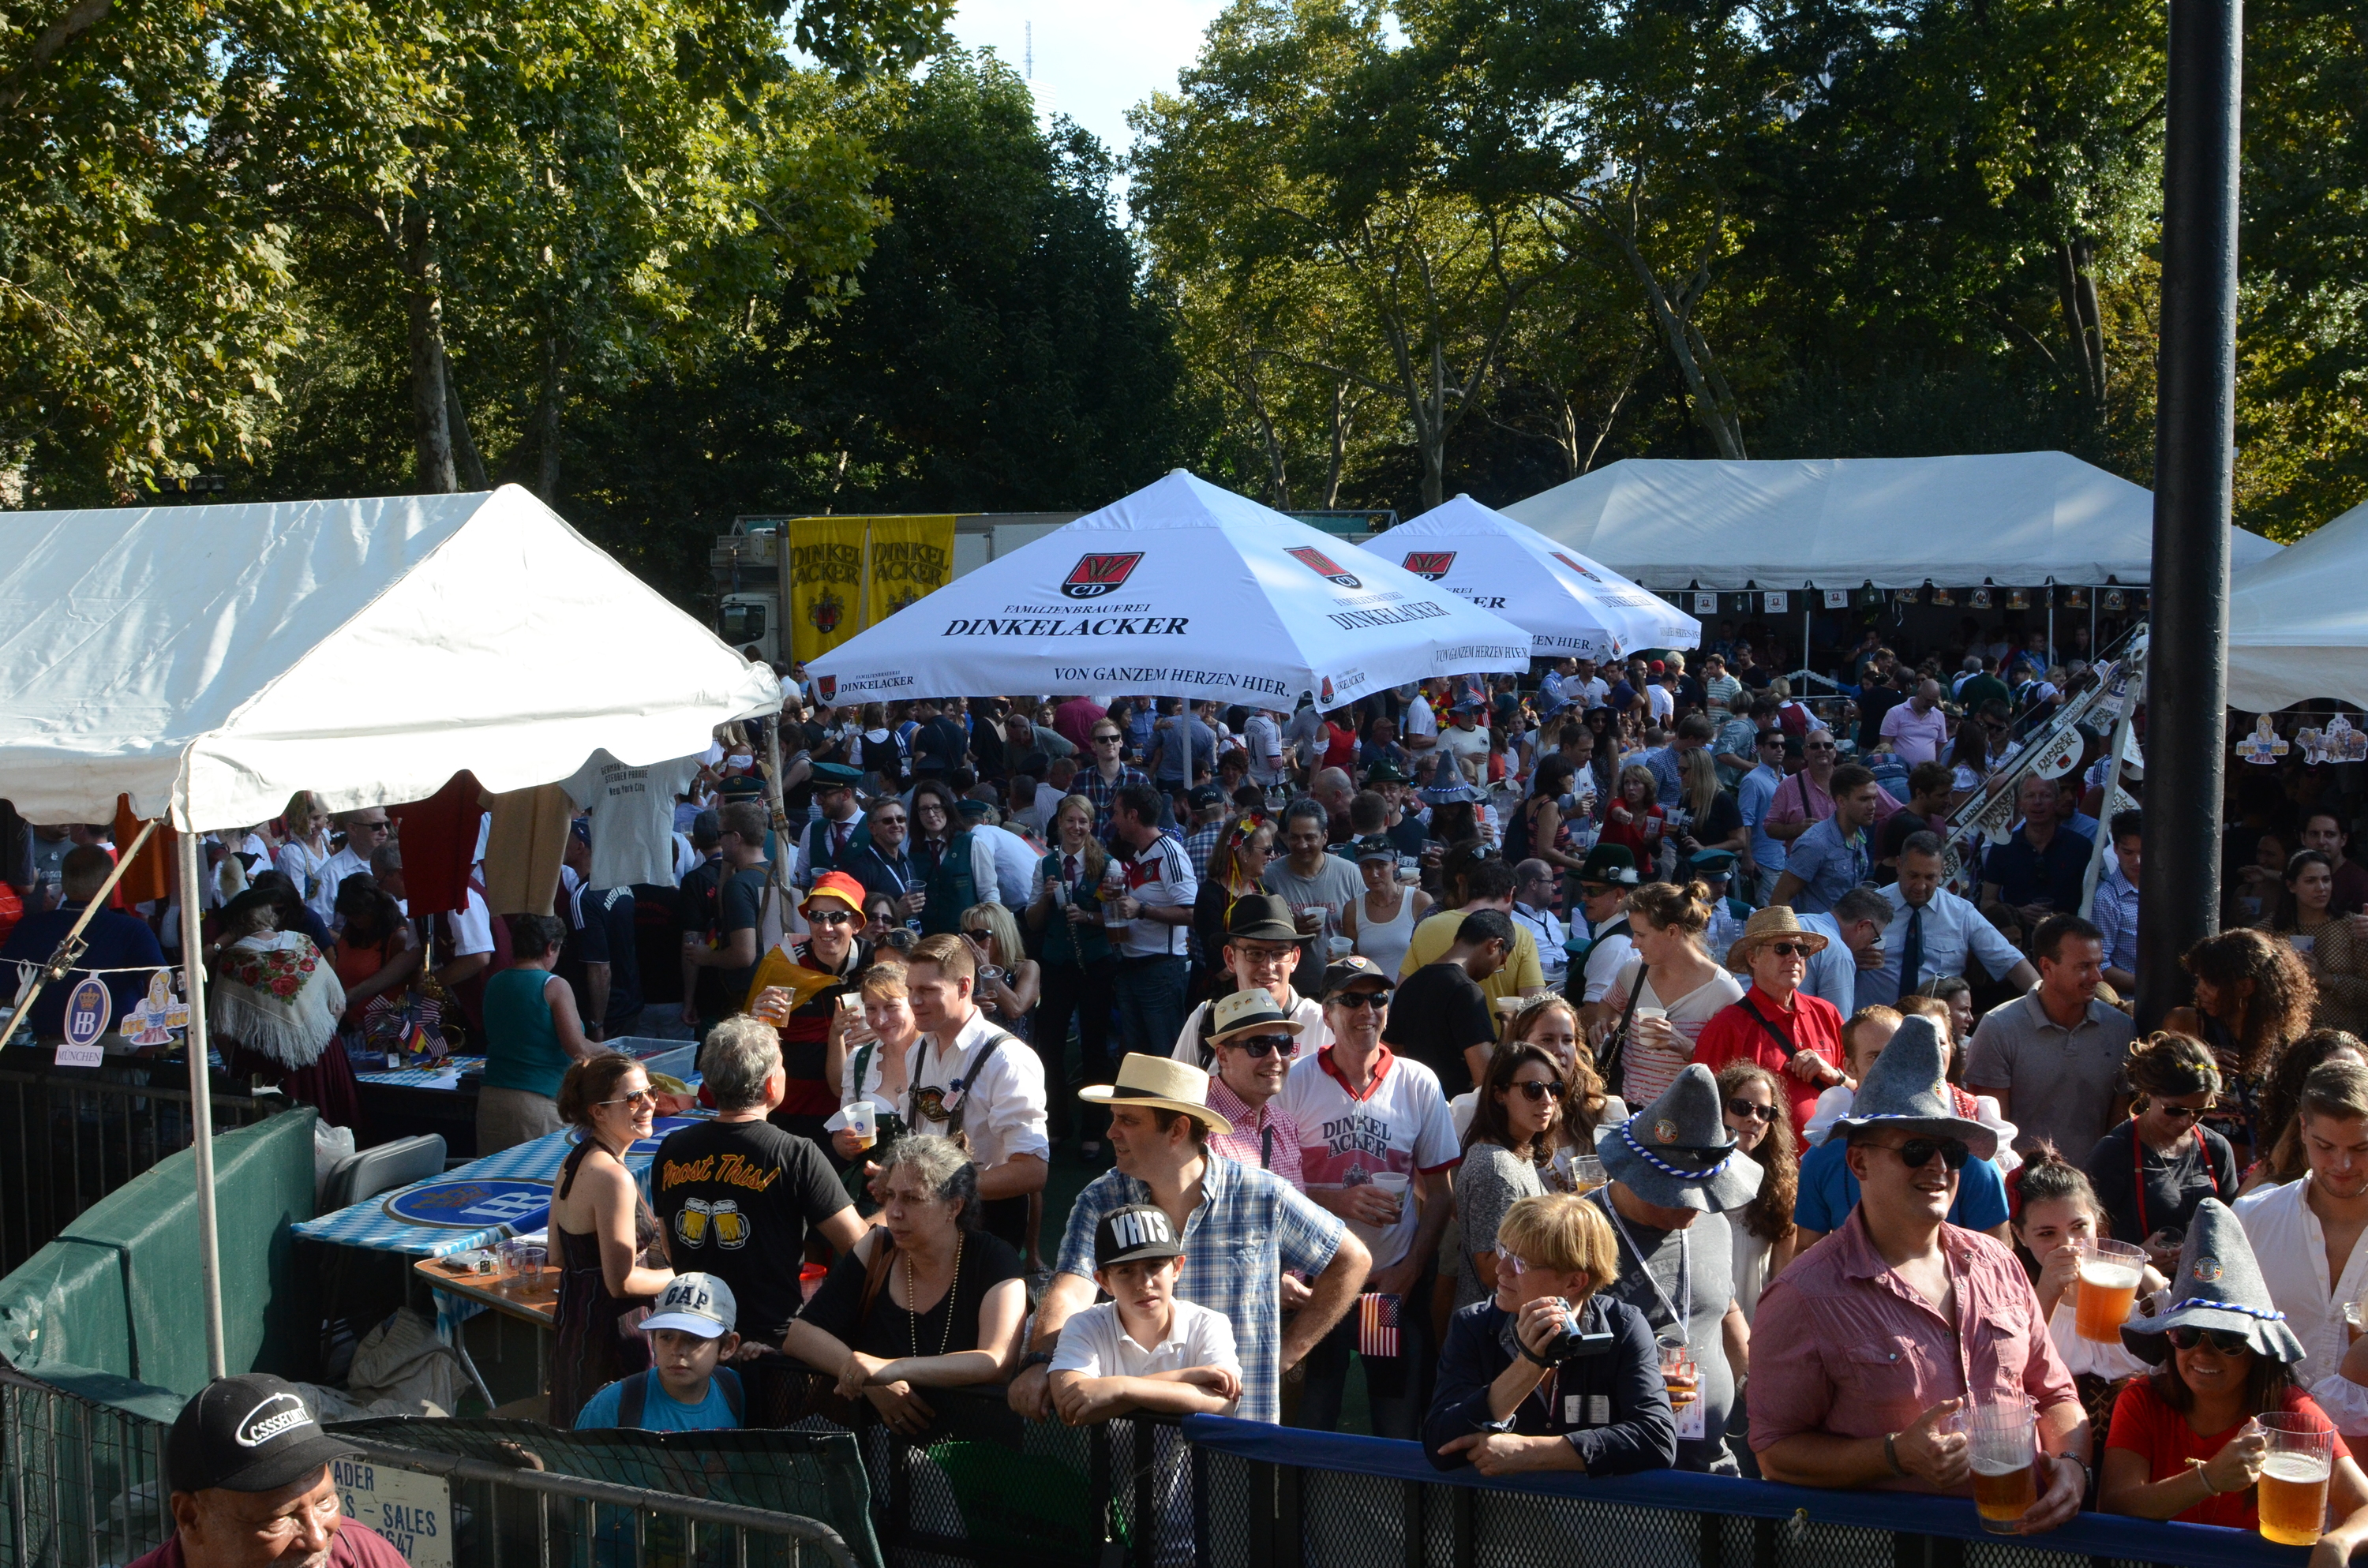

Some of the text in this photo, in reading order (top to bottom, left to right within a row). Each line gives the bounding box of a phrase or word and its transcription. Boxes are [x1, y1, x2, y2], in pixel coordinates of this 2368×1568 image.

[872, 542, 950, 571] DINKEL
[792, 562, 860, 589] ACKER
[874, 561, 943, 588] ACKER
[1336, 576, 1358, 587] CD
[1070, 585, 1106, 597] CD
[1003, 604, 1152, 614] FAMILIENBRAUEREI
[1326, 601, 1452, 630] DINKELACKER
[941, 618, 1190, 637] DINKELACKER
[1435, 649, 1449, 663] VON
[1448, 647, 1474, 661] GANZEM
[1474, 646, 1504, 659] HERZEN
[1557, 637, 1594, 651] HIER.
[841, 676, 914, 693] DINKELACKER
[1055, 668, 1291, 698] VON GANZEM HERZEN HIER.
[2036, 731, 2075, 771] DINKEL
[2044, 737, 2078, 774] ACKER
[605, 769, 648, 784] STEUBEN PARADE
[609, 782, 645, 796] New York City
[603, 887, 620, 911] BAYERN
[73, 1012, 96, 1035] HB
[58, 1049, 101, 1062] MÜNCHEN
[1322, 1114, 1392, 1142] DINKEL
[1327, 1133, 1388, 1162] ACKER
[662, 1154, 781, 1192] Prost This!
[459, 1192, 552, 1218] HB
[1111, 1211, 1170, 1249] VHTS
[665, 1283, 709, 1310] GAP
[383, 1503, 437, 1537] SALES
